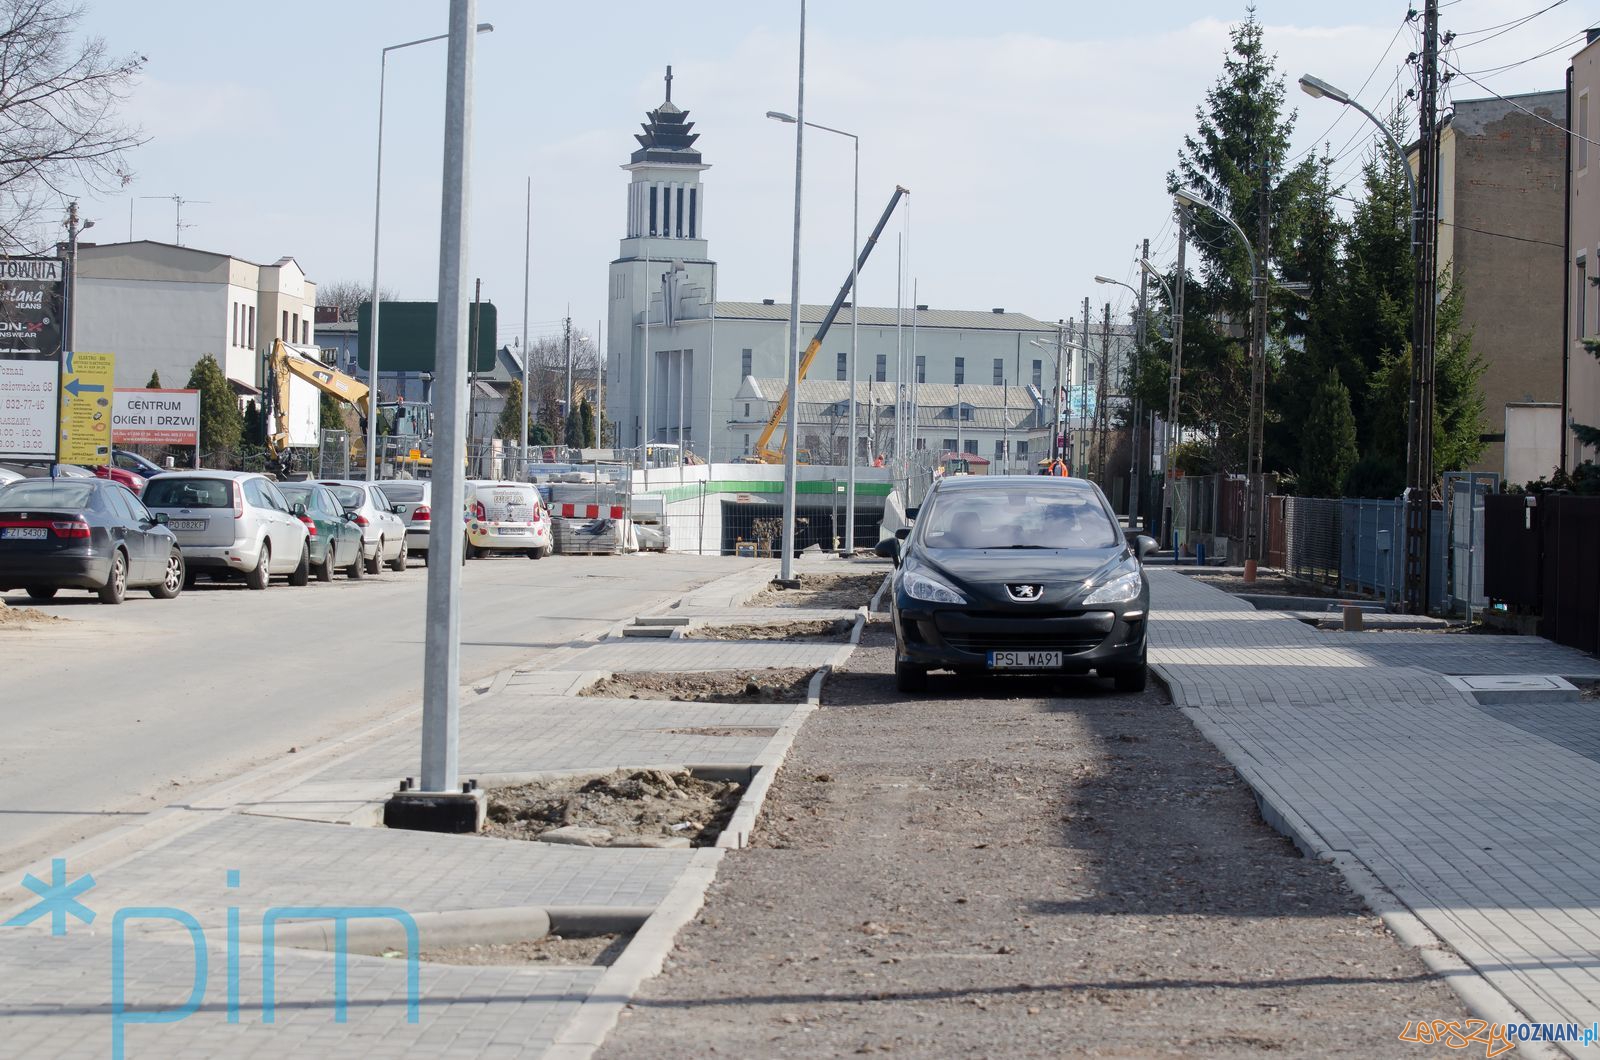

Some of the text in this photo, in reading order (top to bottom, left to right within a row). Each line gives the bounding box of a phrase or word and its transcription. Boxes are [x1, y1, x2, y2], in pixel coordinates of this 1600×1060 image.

[16, 302, 42, 310] JEANS
[127, 400, 181, 411] CENTRUM
[112, 415, 146, 425] OKIEN
[157, 416, 195, 426] DRZWI
[995, 652, 1059, 666] PSL WA91
